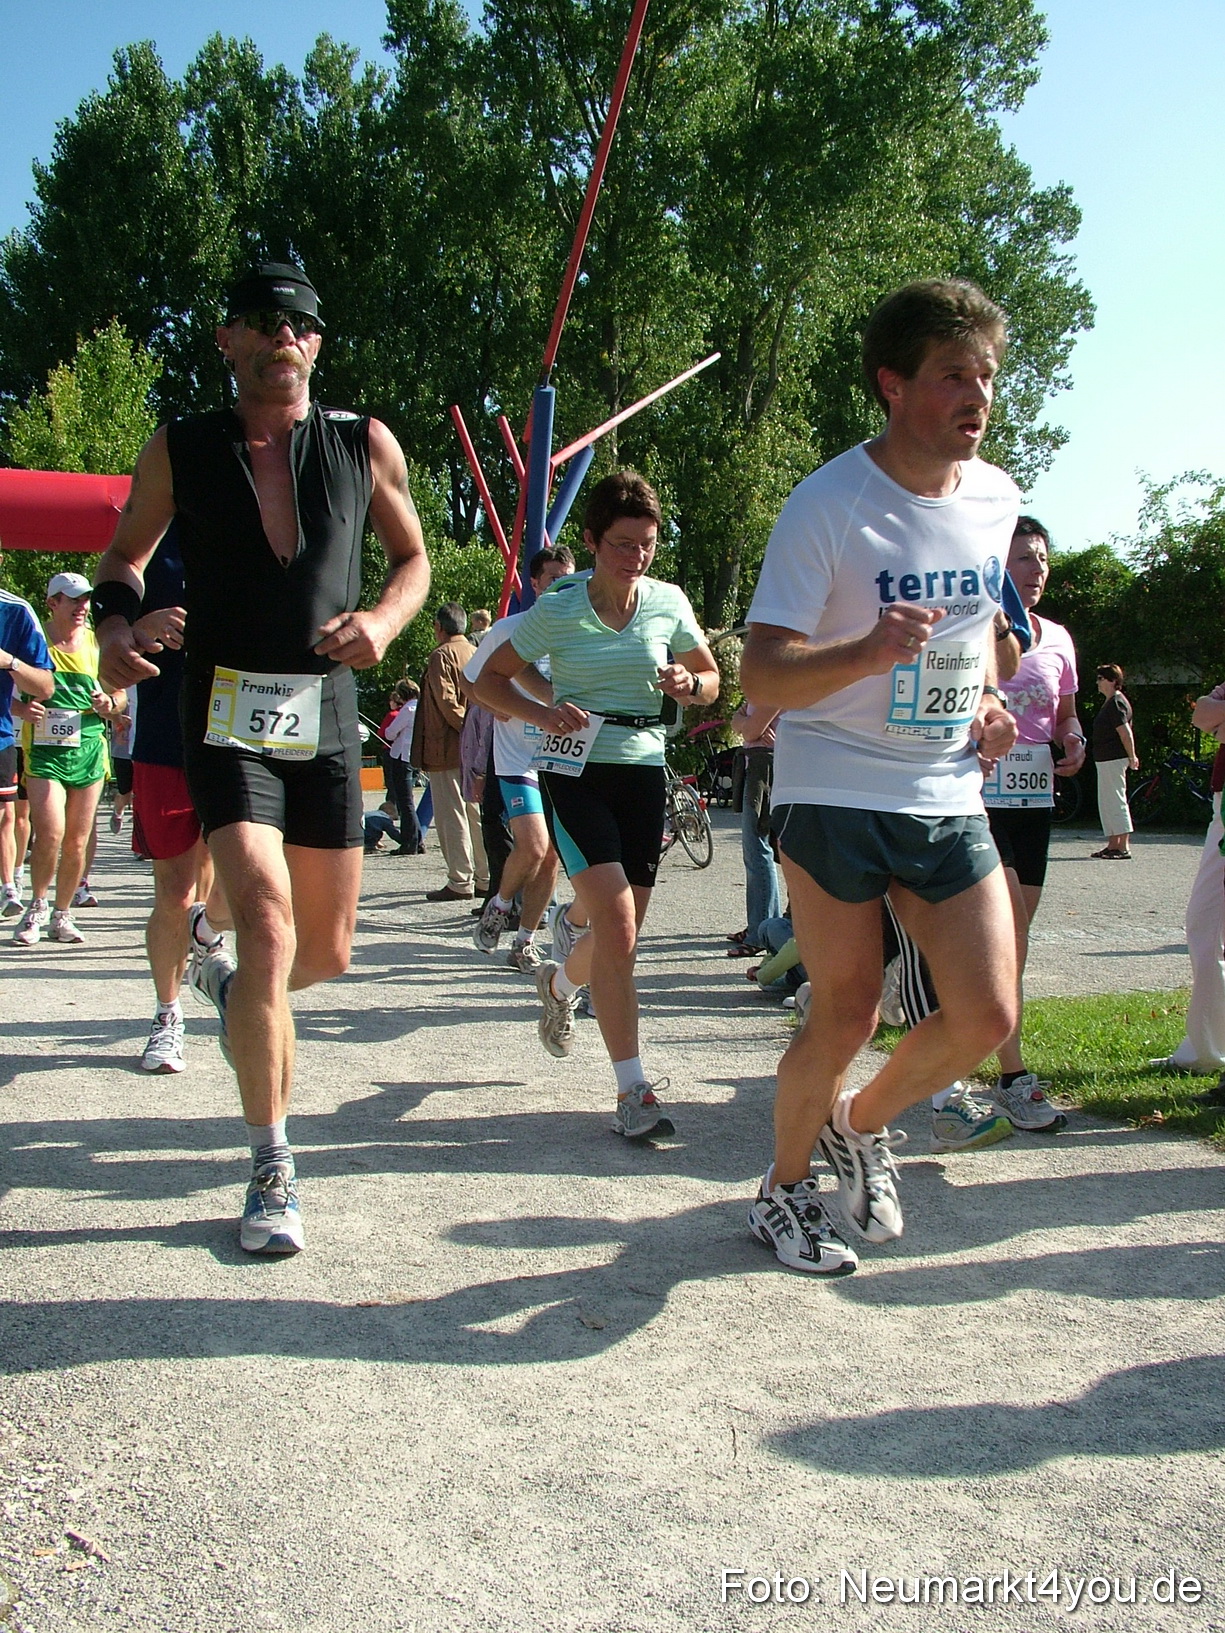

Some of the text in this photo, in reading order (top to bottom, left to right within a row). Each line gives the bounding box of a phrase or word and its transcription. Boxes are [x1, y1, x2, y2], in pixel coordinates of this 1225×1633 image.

[875, 569, 980, 604] terra
[926, 650, 980, 671] Reinhard
[897, 680, 905, 694] C
[213, 699, 221, 712] B
[924, 685, 979, 714] 2827
[51, 724, 74, 736] 658
[248, 708, 300, 737] 572
[273, 747, 315, 758] PFLEIDERER
[542, 734, 587, 758] 3505
[1006, 772, 1048, 790] 3506
